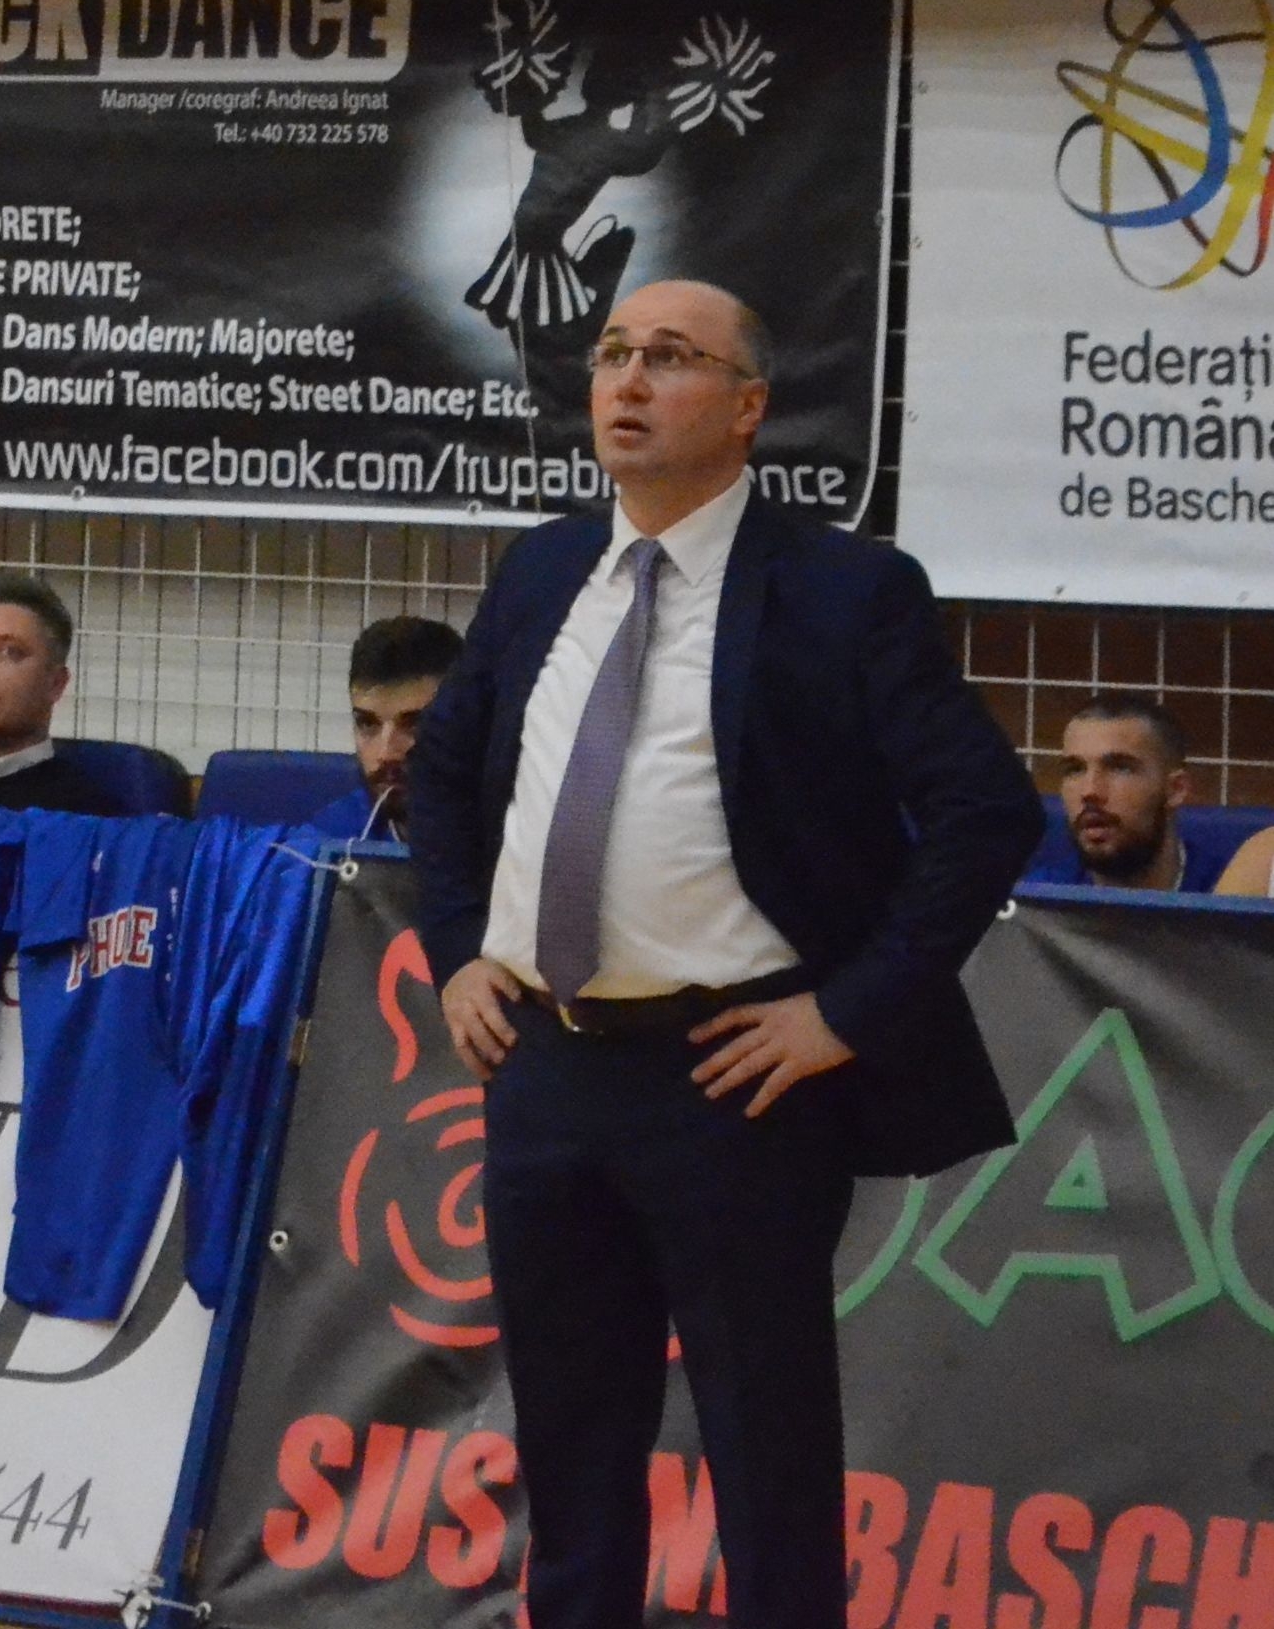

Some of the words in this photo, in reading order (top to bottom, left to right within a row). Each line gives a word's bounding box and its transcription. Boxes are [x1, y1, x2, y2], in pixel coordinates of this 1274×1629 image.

[100, 88, 175, 115] Manager
[265, 88, 339, 111] Andreea
[342, 88, 390, 115] Ignat
[251, 124, 283, 144] +40
[286, 124, 318, 144] 732
[321, 124, 353, 144] 225
[356, 124, 390, 144] 578
[11, 260, 143, 303] PRIVATE;
[2, 313, 77, 352] Dans
[81, 315, 205, 360] Modern;
[208, 317, 357, 365] Majorete;
[1, 367, 115, 406] Dansuri
[121, 370, 263, 415] Tematice;
[269, 375, 364, 414] Street
[368, 379, 476, 422] Dance;
[481, 380, 540, 420] Etc.
[1061, 394, 1274, 461] Român
[1059, 471, 1113, 518] de
